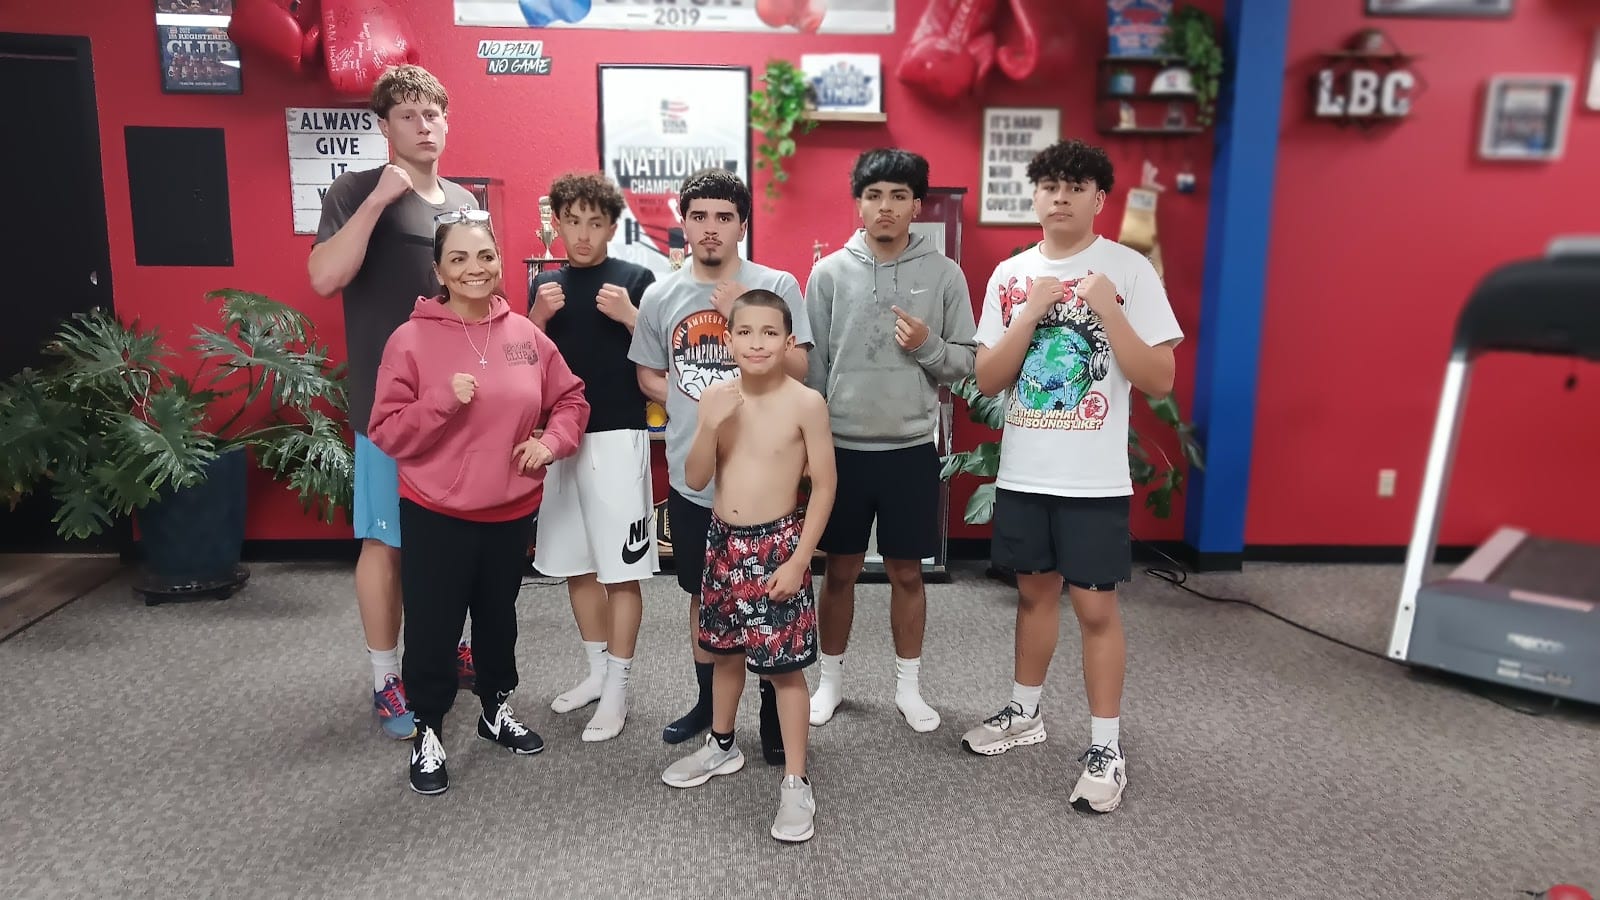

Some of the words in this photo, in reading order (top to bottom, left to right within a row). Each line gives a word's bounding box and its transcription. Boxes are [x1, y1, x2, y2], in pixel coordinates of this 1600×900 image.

[654, 8, 700, 26] 2019
[166, 40, 232, 55] CLUB
[479, 41, 501, 56] NO
[502, 42, 541, 57] PAIN
[489, 59, 509, 73] NO
[511, 58, 551, 73] GAME
[1316, 69, 1414, 116] LBC
[300, 112, 372, 130] ALWAYS
[1013, 116, 1043, 130] HARD
[316, 137, 360, 155] GIVE
[990, 132, 1003, 145] TO
[1006, 132, 1032, 145] BEAT
[989, 149, 996, 162] A
[331, 163, 348, 180] IT
[989, 165, 1012, 178] WHO
[630, 179, 681, 194] CHAMPIO
[988, 182, 1022, 194] NEVER
[986, 198, 1017, 211] GIVES
[687, 314, 722, 329] AMATEUR
[1026, 419, 1072, 430] SOUNDS
[1072, 420, 1103, 430] LIKE?
[629, 517, 648, 545] NI
